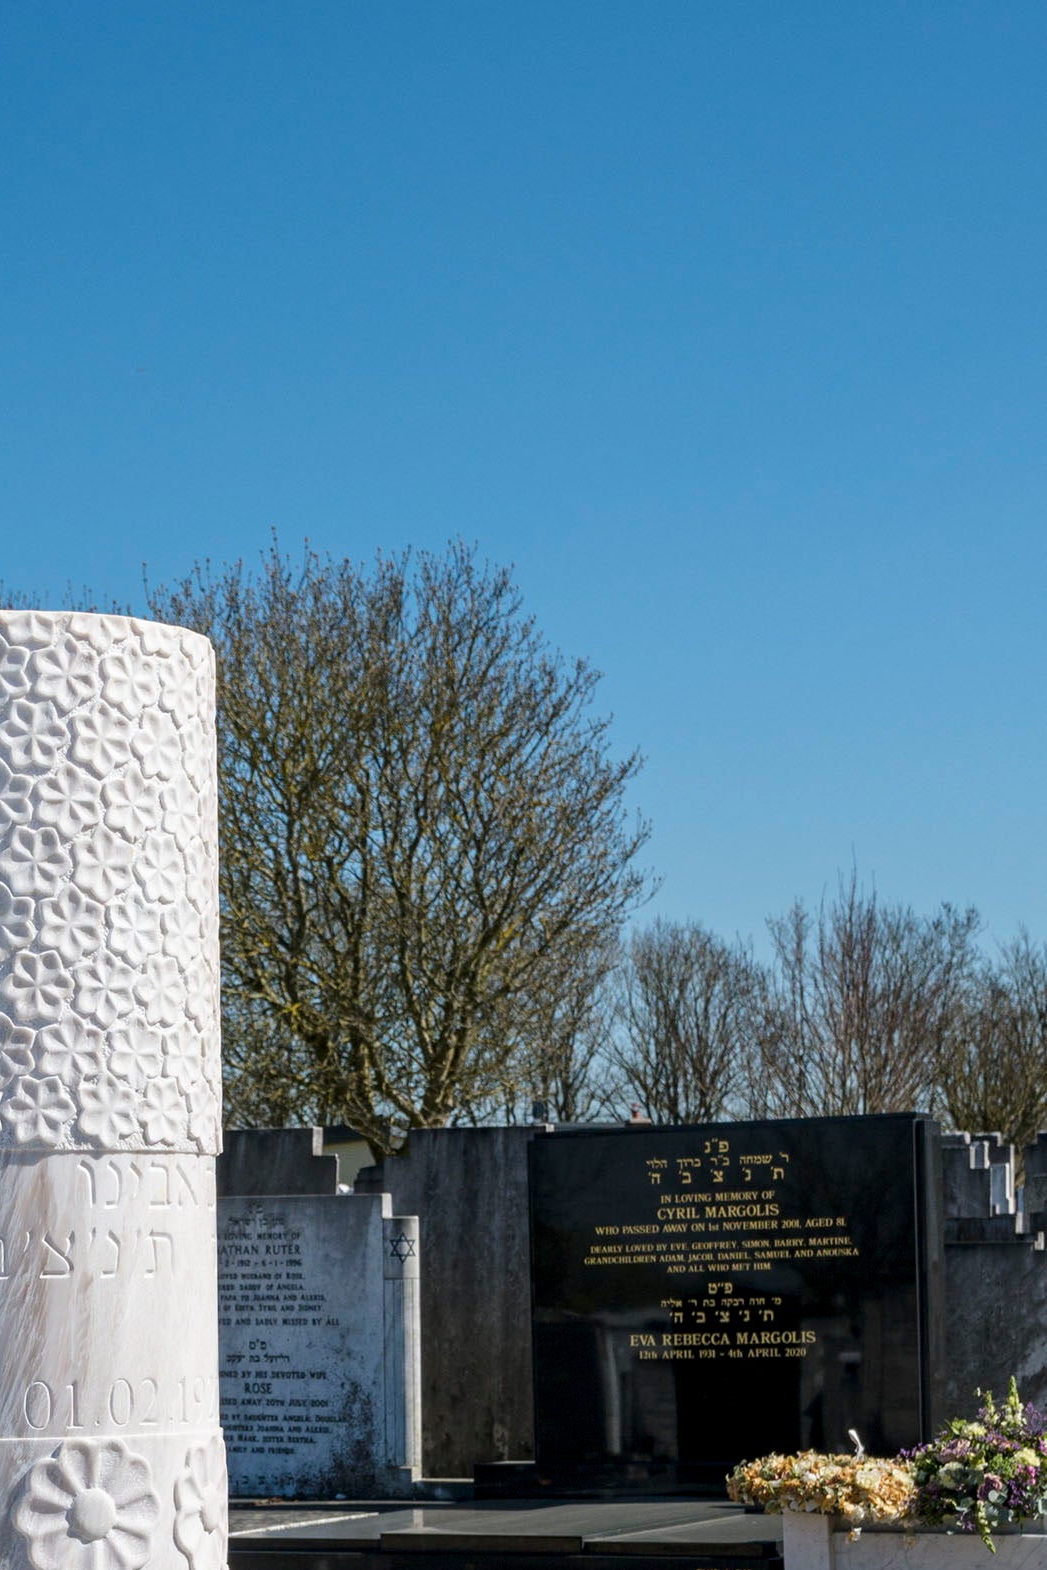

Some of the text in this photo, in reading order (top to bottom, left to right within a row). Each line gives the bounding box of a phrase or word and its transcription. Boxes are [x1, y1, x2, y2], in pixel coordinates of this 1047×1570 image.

[646, 1157, 668, 1168] הלוי
[676, 1158, 701, 1169] ברוך
[740, 1154, 773, 1165] שמחה
[660, 1190, 775, 1204] IN LOVING MEMORY OF
[657, 1203, 779, 1220] CYRIL MARGOLIS
[595, 1226, 619, 1235] WHO
[622, 1224, 659, 1234] PASSED
[662, 1223, 688, 1233] AWAY
[691, 1223, 705, 1232] ON
[708, 1222, 719, 1231] 1st
[722, 1220, 778, 1231] NOVEMBER
[805, 1218, 833, 1227] AGED
[257, 1232, 287, 1240] MEMORY
[291, 1232, 300, 1240] OF
[265, 1245, 301, 1256] RUTER
[590, 1245, 622, 1254] DEARLY
[625, 1244, 654, 1252] LOVED
[656, 1243, 667, 1251] BY
[584, 1248, 859, 1265] GRANDCHILDREN SAMUEL AND ANOUSKA
[666, 1261, 771, 1274] AND ALL WHO MET HIM
[283, 1294, 297, 1302] AND
[235, 1317, 340, 1327] AND SADLY MISSED BY ALL
[629, 1331, 816, 1347] EVA REBECCA MARGOLIS
[639, 1347, 807, 1360] 12th APRIL 1931 4th APRIL 2020
[271, 1371, 306, 1379] DEVOTED
[244, 1383, 272, 1394] ROSE
[240, 1399, 263, 1407] AWAY
